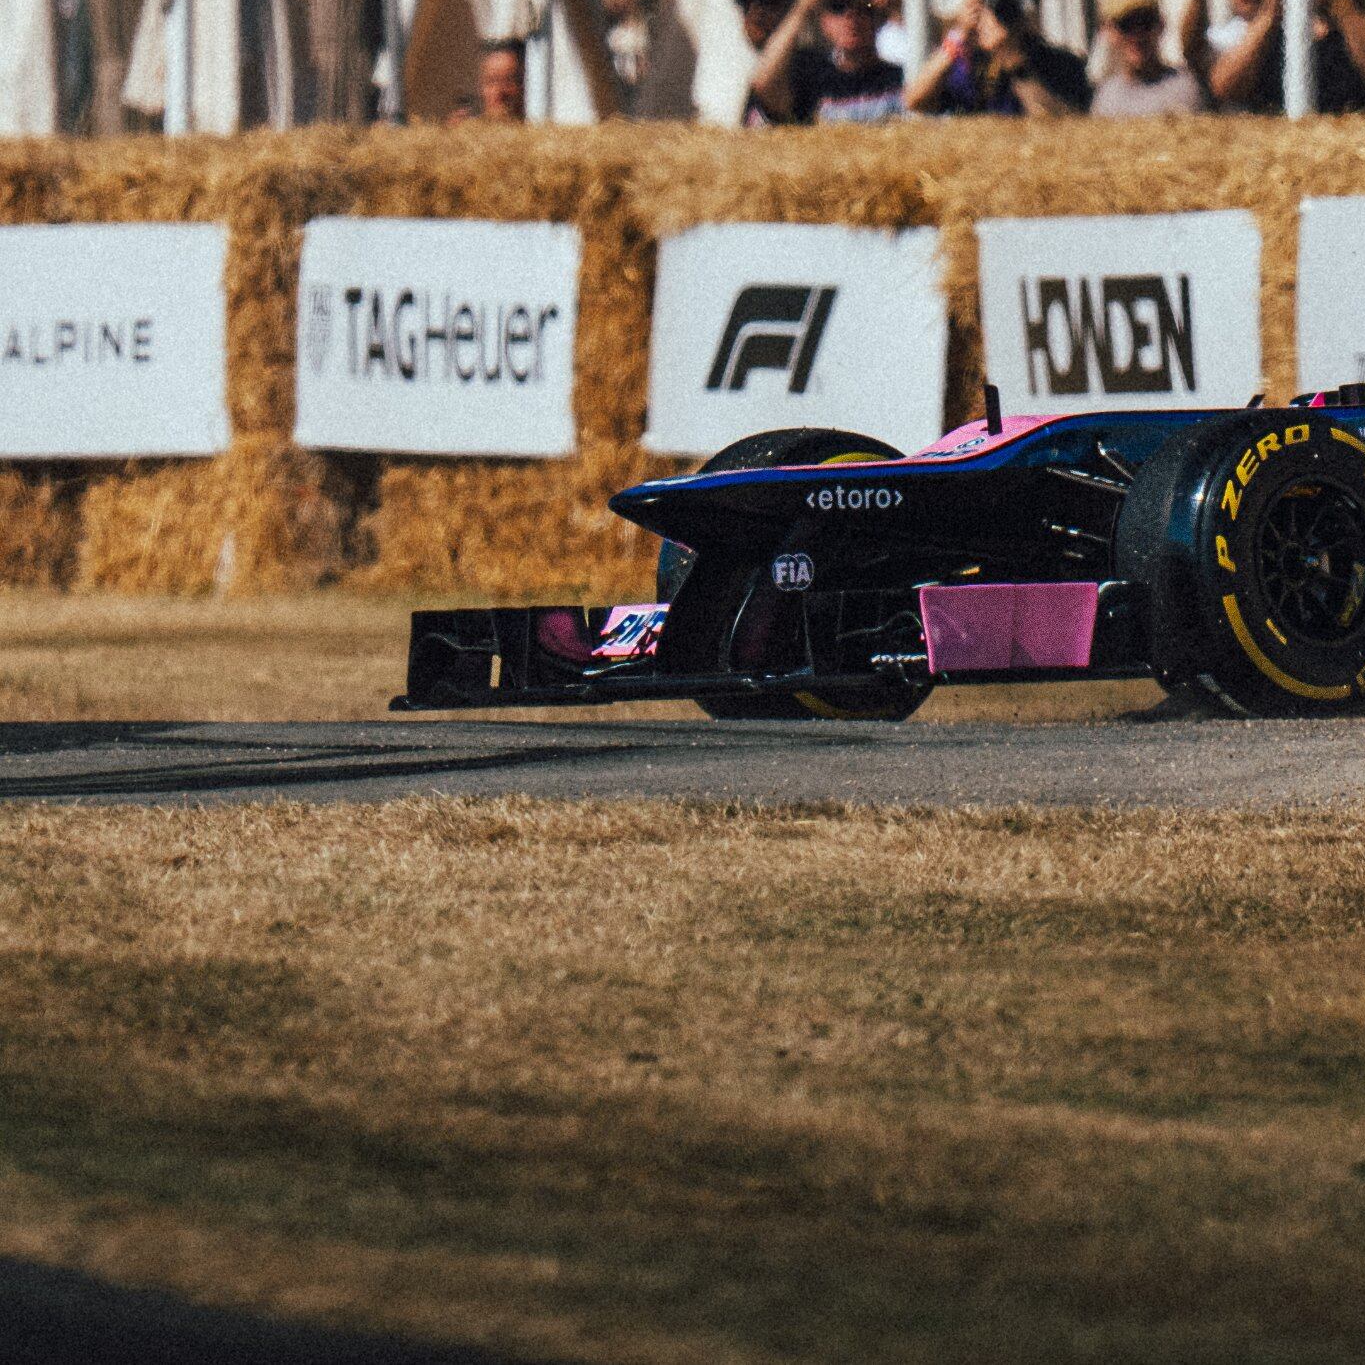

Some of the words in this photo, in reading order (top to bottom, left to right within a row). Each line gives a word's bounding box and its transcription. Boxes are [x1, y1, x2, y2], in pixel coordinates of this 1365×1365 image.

[3, 317, 152, 364] ALPINE
[1221, 424, 1310, 521] ZERO
[775, 561, 811, 583] FIA
[1215, 535, 1237, 573] P
